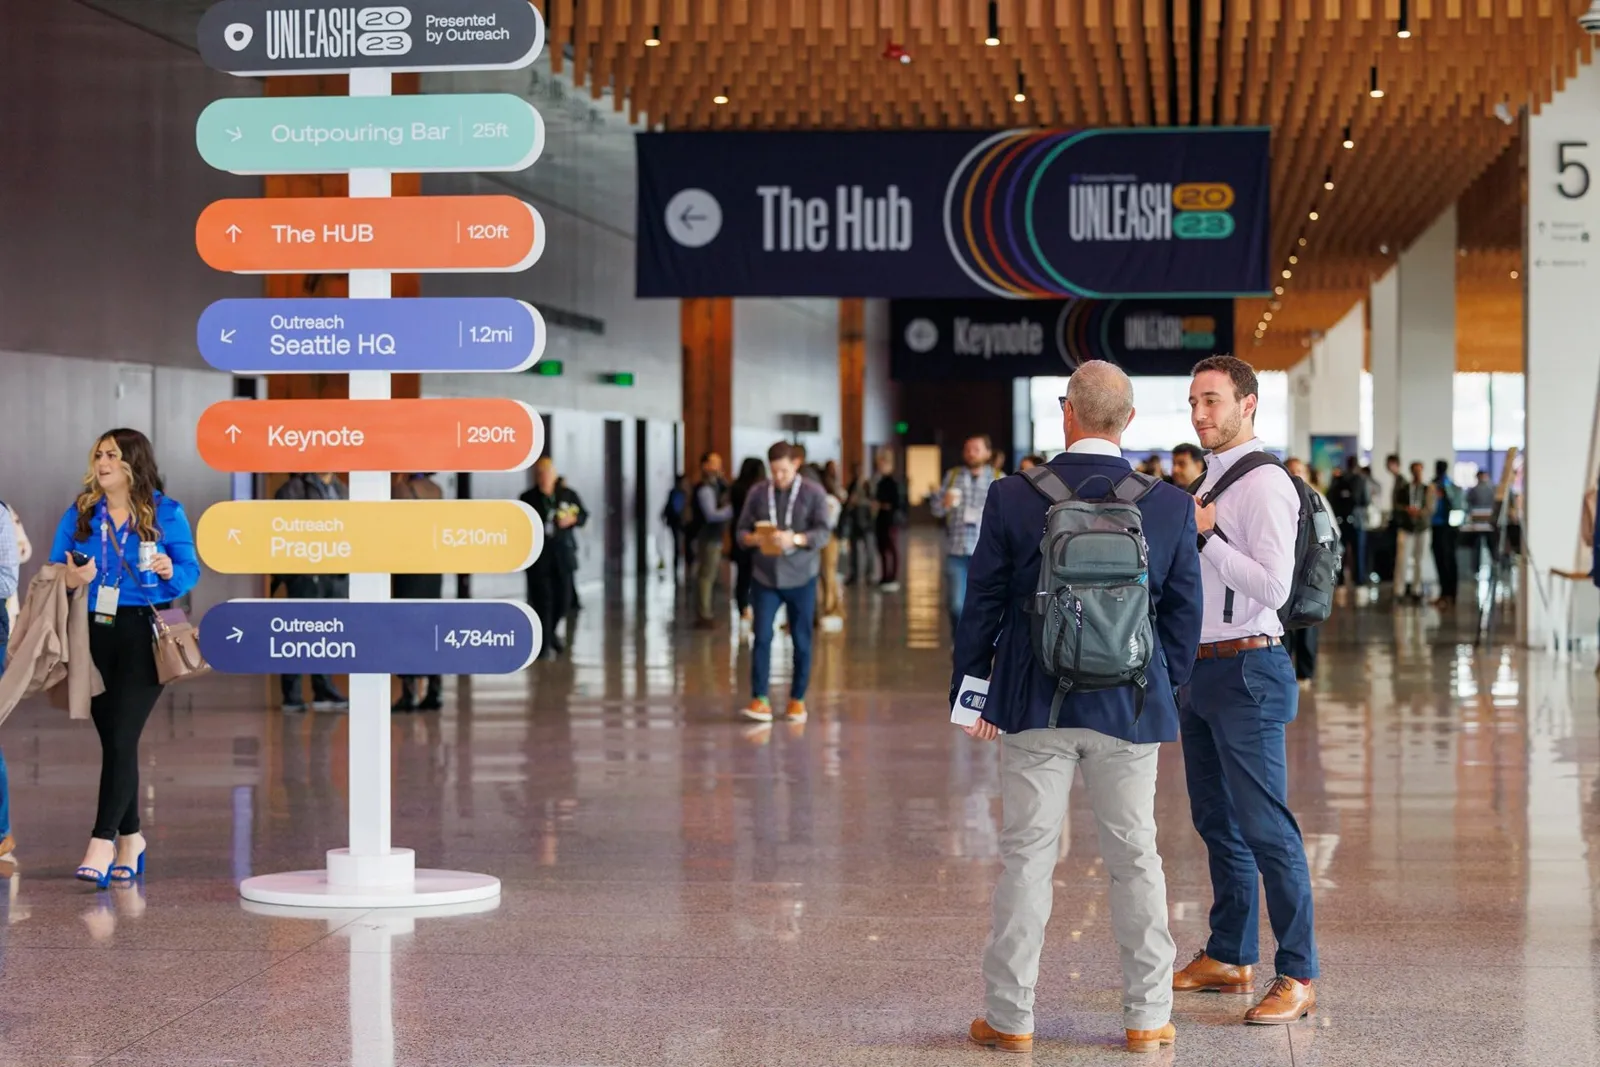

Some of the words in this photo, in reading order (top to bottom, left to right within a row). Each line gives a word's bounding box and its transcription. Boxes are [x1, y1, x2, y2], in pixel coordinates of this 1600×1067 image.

[365, 11, 405, 26] 20
[426, 13, 496, 28] Presented
[266, 8, 356, 59] UNLEASH
[426, 29, 443, 45] by
[445, 27, 510, 42] Outreach
[366, 36, 405, 51] 23
[271, 123, 404, 146] Outpouring
[410, 122, 451, 141] Bar
[472, 123, 509, 138] 25ft
[1557, 141, 1590, 199] 5
[1181, 188, 1225, 204] 20
[756, 184, 829, 252] The
[836, 183, 913, 252] Hub
[1069, 182, 1172, 241] UNLEASH
[467, 224, 510, 239] 120ft
[1181, 215, 1225, 233] 23
[271, 225, 316, 243] The
[322, 224, 375, 243] HUB
[270, 315, 344, 330] Outreach
[469, 326, 513, 343] 1.2mi
[953, 315, 1043, 359] Keynote
[269, 334, 351, 355] Seattle
[358, 334, 396, 355] HQ
[267, 426, 364, 451] Keynote
[467, 426, 516, 443] 290ft
[271, 517, 344, 532] Outreach
[441, 528, 508, 546] 5,210mi
[270, 538, 351, 562] Prague
[270, 617, 344, 633] Outreach
[269, 637, 356, 658] London
[443, 630, 515, 648] 4,784mi
